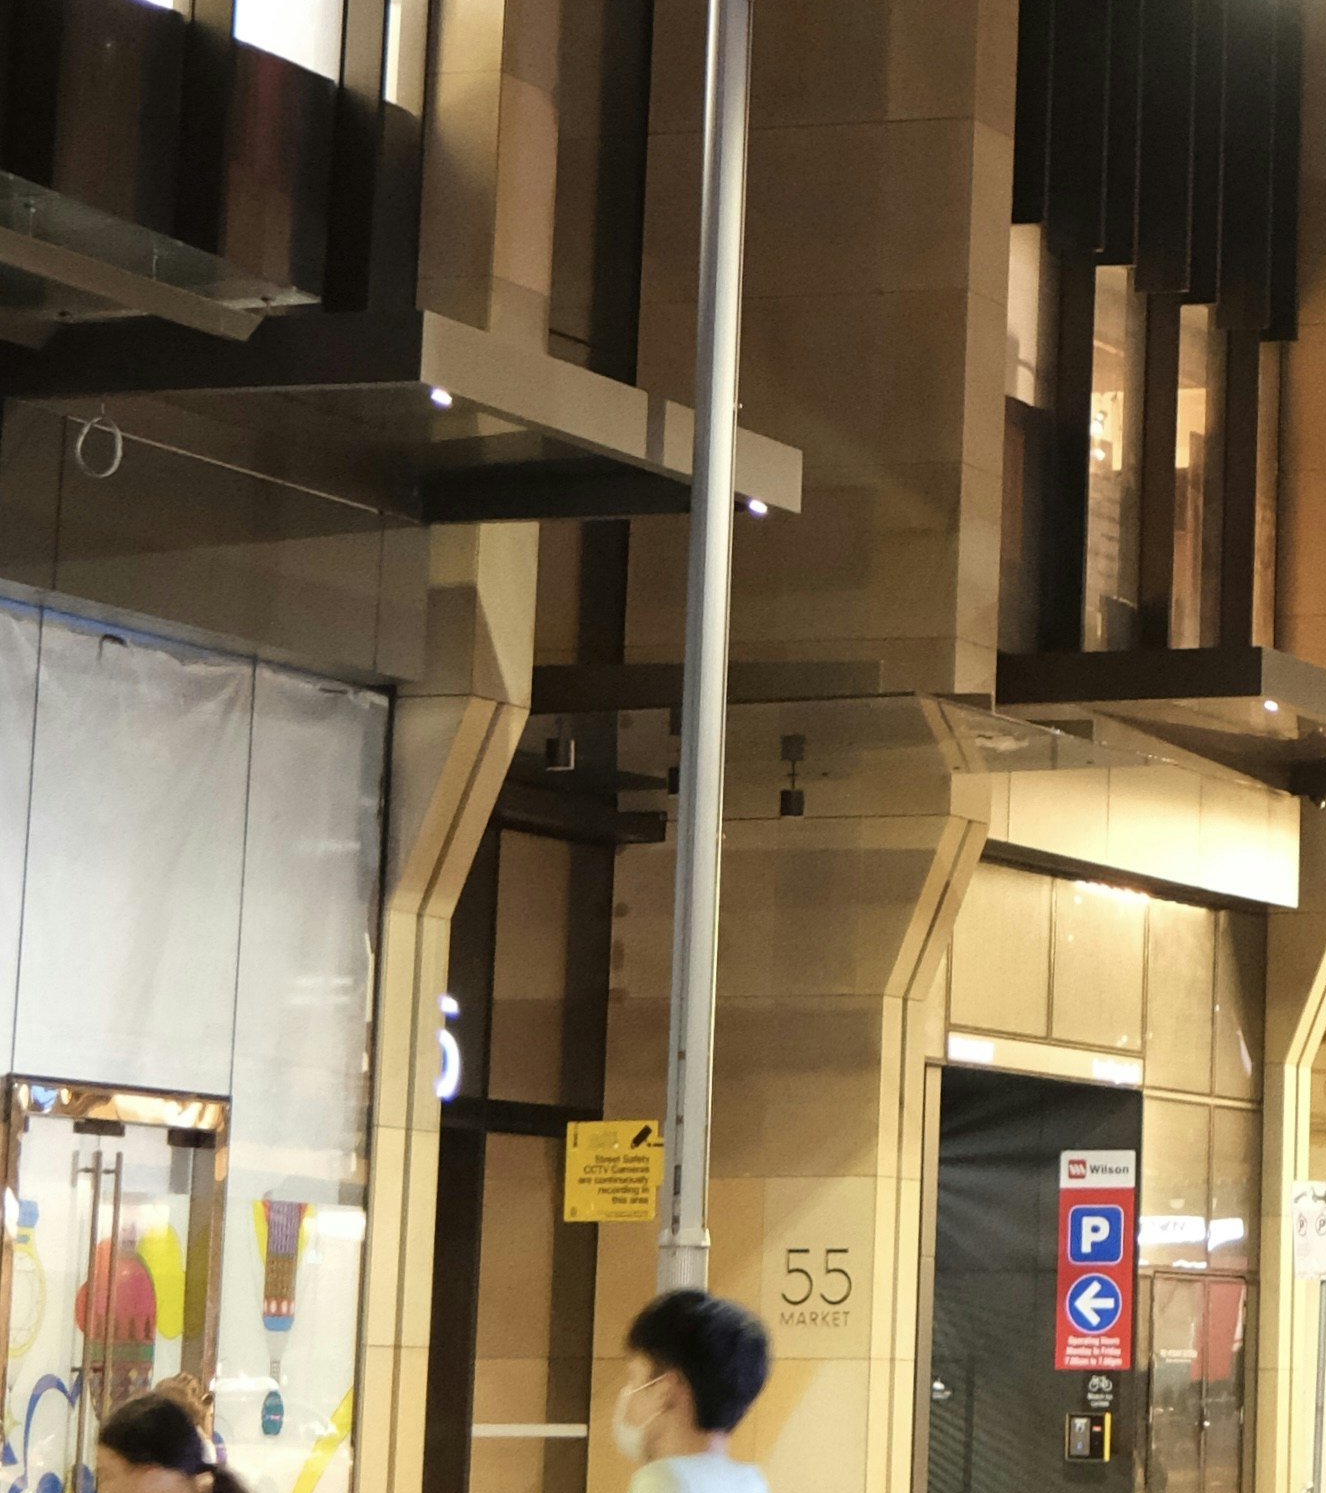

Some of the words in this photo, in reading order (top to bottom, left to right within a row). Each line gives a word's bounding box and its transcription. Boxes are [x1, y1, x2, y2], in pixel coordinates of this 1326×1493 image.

[583, 1165, 609, 1174] CCTV
[1089, 1163, 1129, 1175] Wilson
[1081, 1215, 1110, 1254] P
[781, 1248, 852, 1306] 55
[780, 1310, 851, 1328] MARKET
